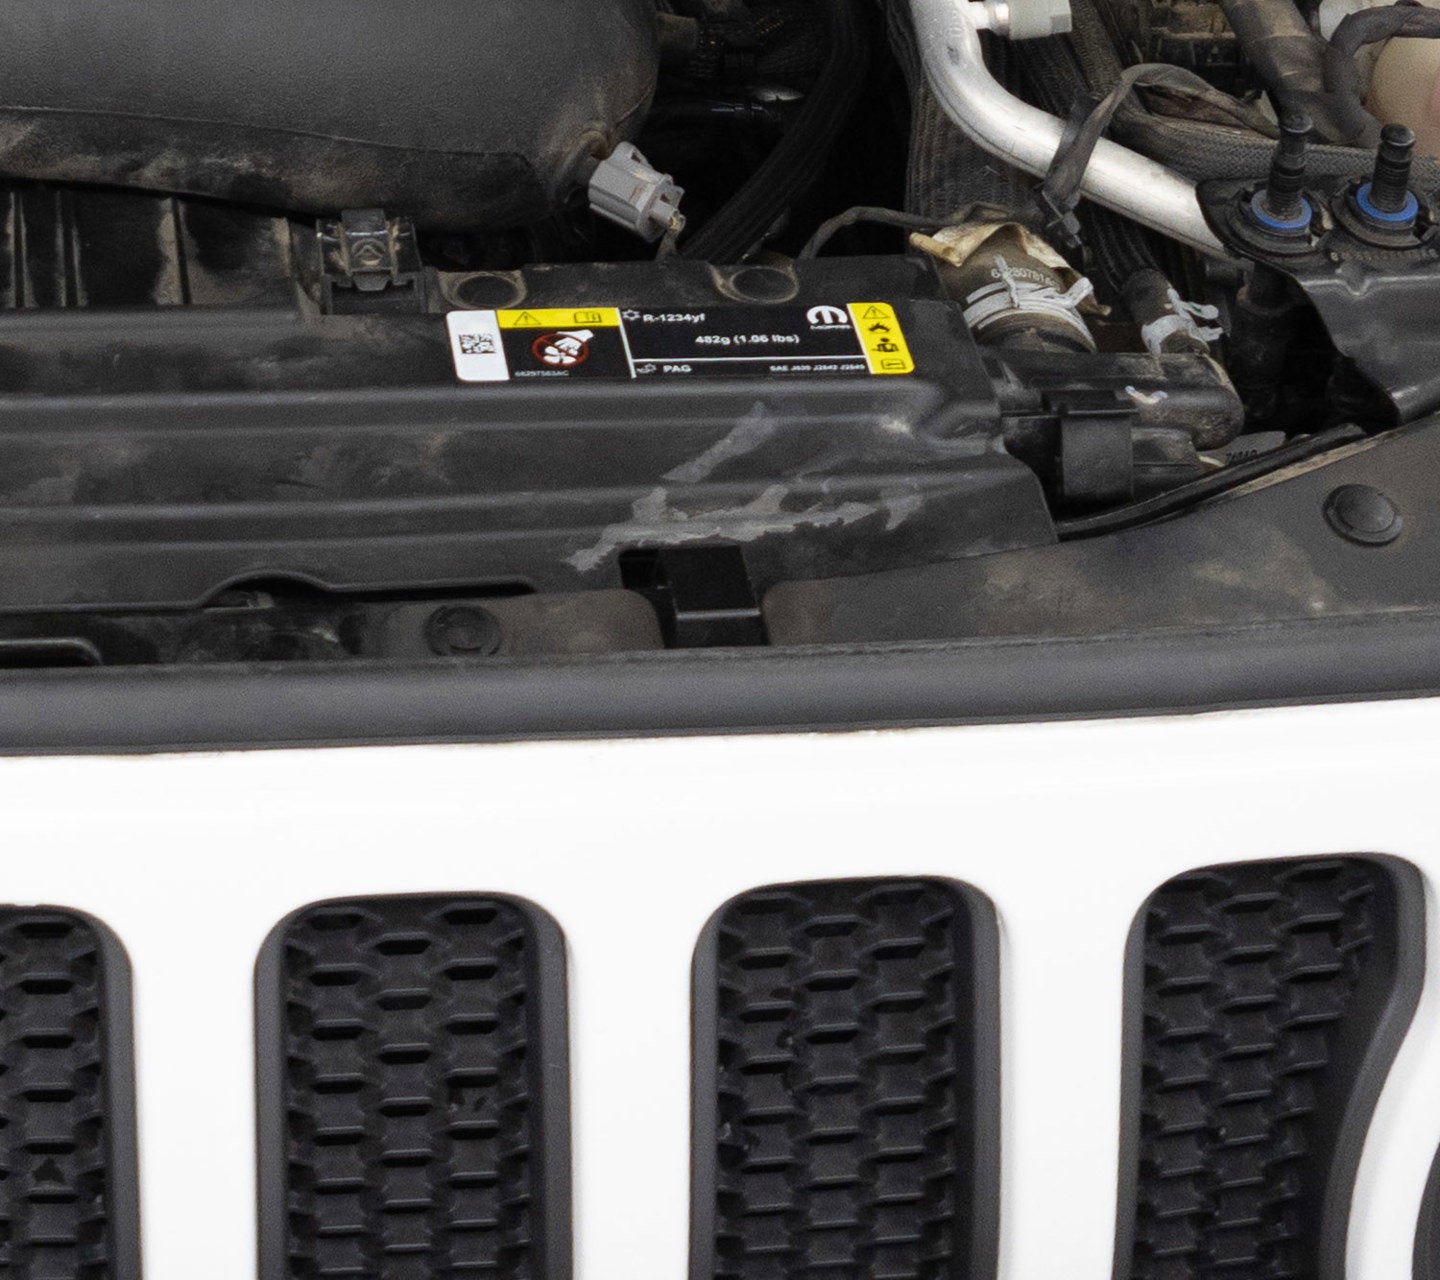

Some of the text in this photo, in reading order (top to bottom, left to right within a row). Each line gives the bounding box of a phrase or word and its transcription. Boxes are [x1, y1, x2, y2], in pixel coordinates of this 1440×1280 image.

[642, 312, 706, 324] R-1234yf
[771, 333, 801, 344] lbs)
[662, 364, 693, 373] PAG
